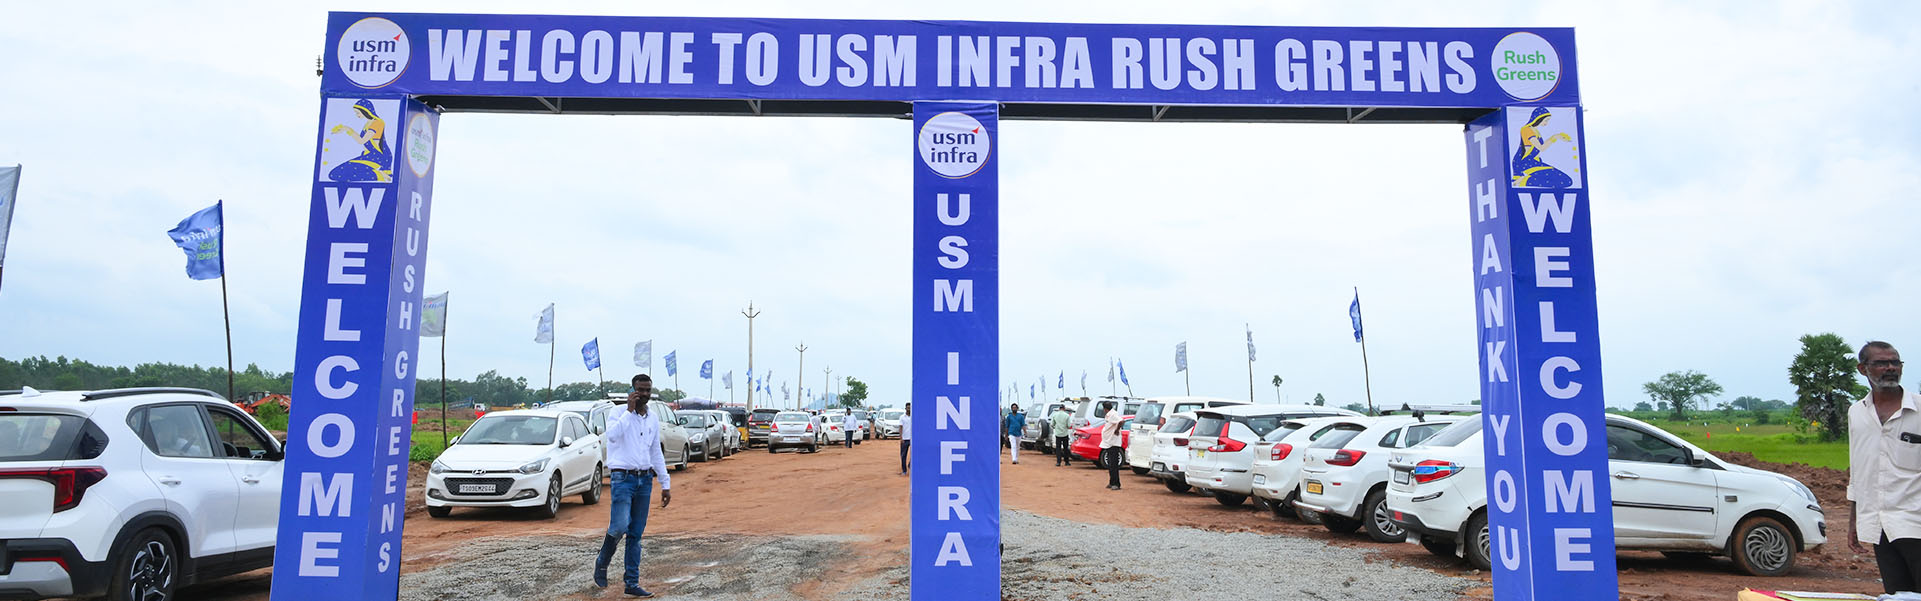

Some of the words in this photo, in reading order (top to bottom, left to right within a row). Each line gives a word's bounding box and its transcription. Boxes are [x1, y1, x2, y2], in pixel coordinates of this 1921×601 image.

[349, 54, 396, 73] infra
[353, 40, 396, 53] usm
[428, 28, 694, 84] WELCOME
[712, 32, 779, 86] TO
[798, 33, 917, 88] USM
[937, 35, 1095, 89] INFRA
[1111, 37, 1256, 91] RUSH
[1275, 38, 1477, 94] GREENS
[1496, 67, 1557, 81] Greens
[1504, 50, 1546, 64] Rush
[931, 146, 978, 163] infra
[932, 132, 976, 145] usm
[399, 191, 423, 330] RUSH
[933, 193, 974, 313] USM
[1473, 126, 1509, 383] THANK
[298, 187, 386, 578] WELCOME
[1517, 192, 1596, 572] WELCOME
[377, 350, 409, 573] GREENS
[934, 351, 974, 567] INFRA
[1489, 414, 1521, 572] YOU
